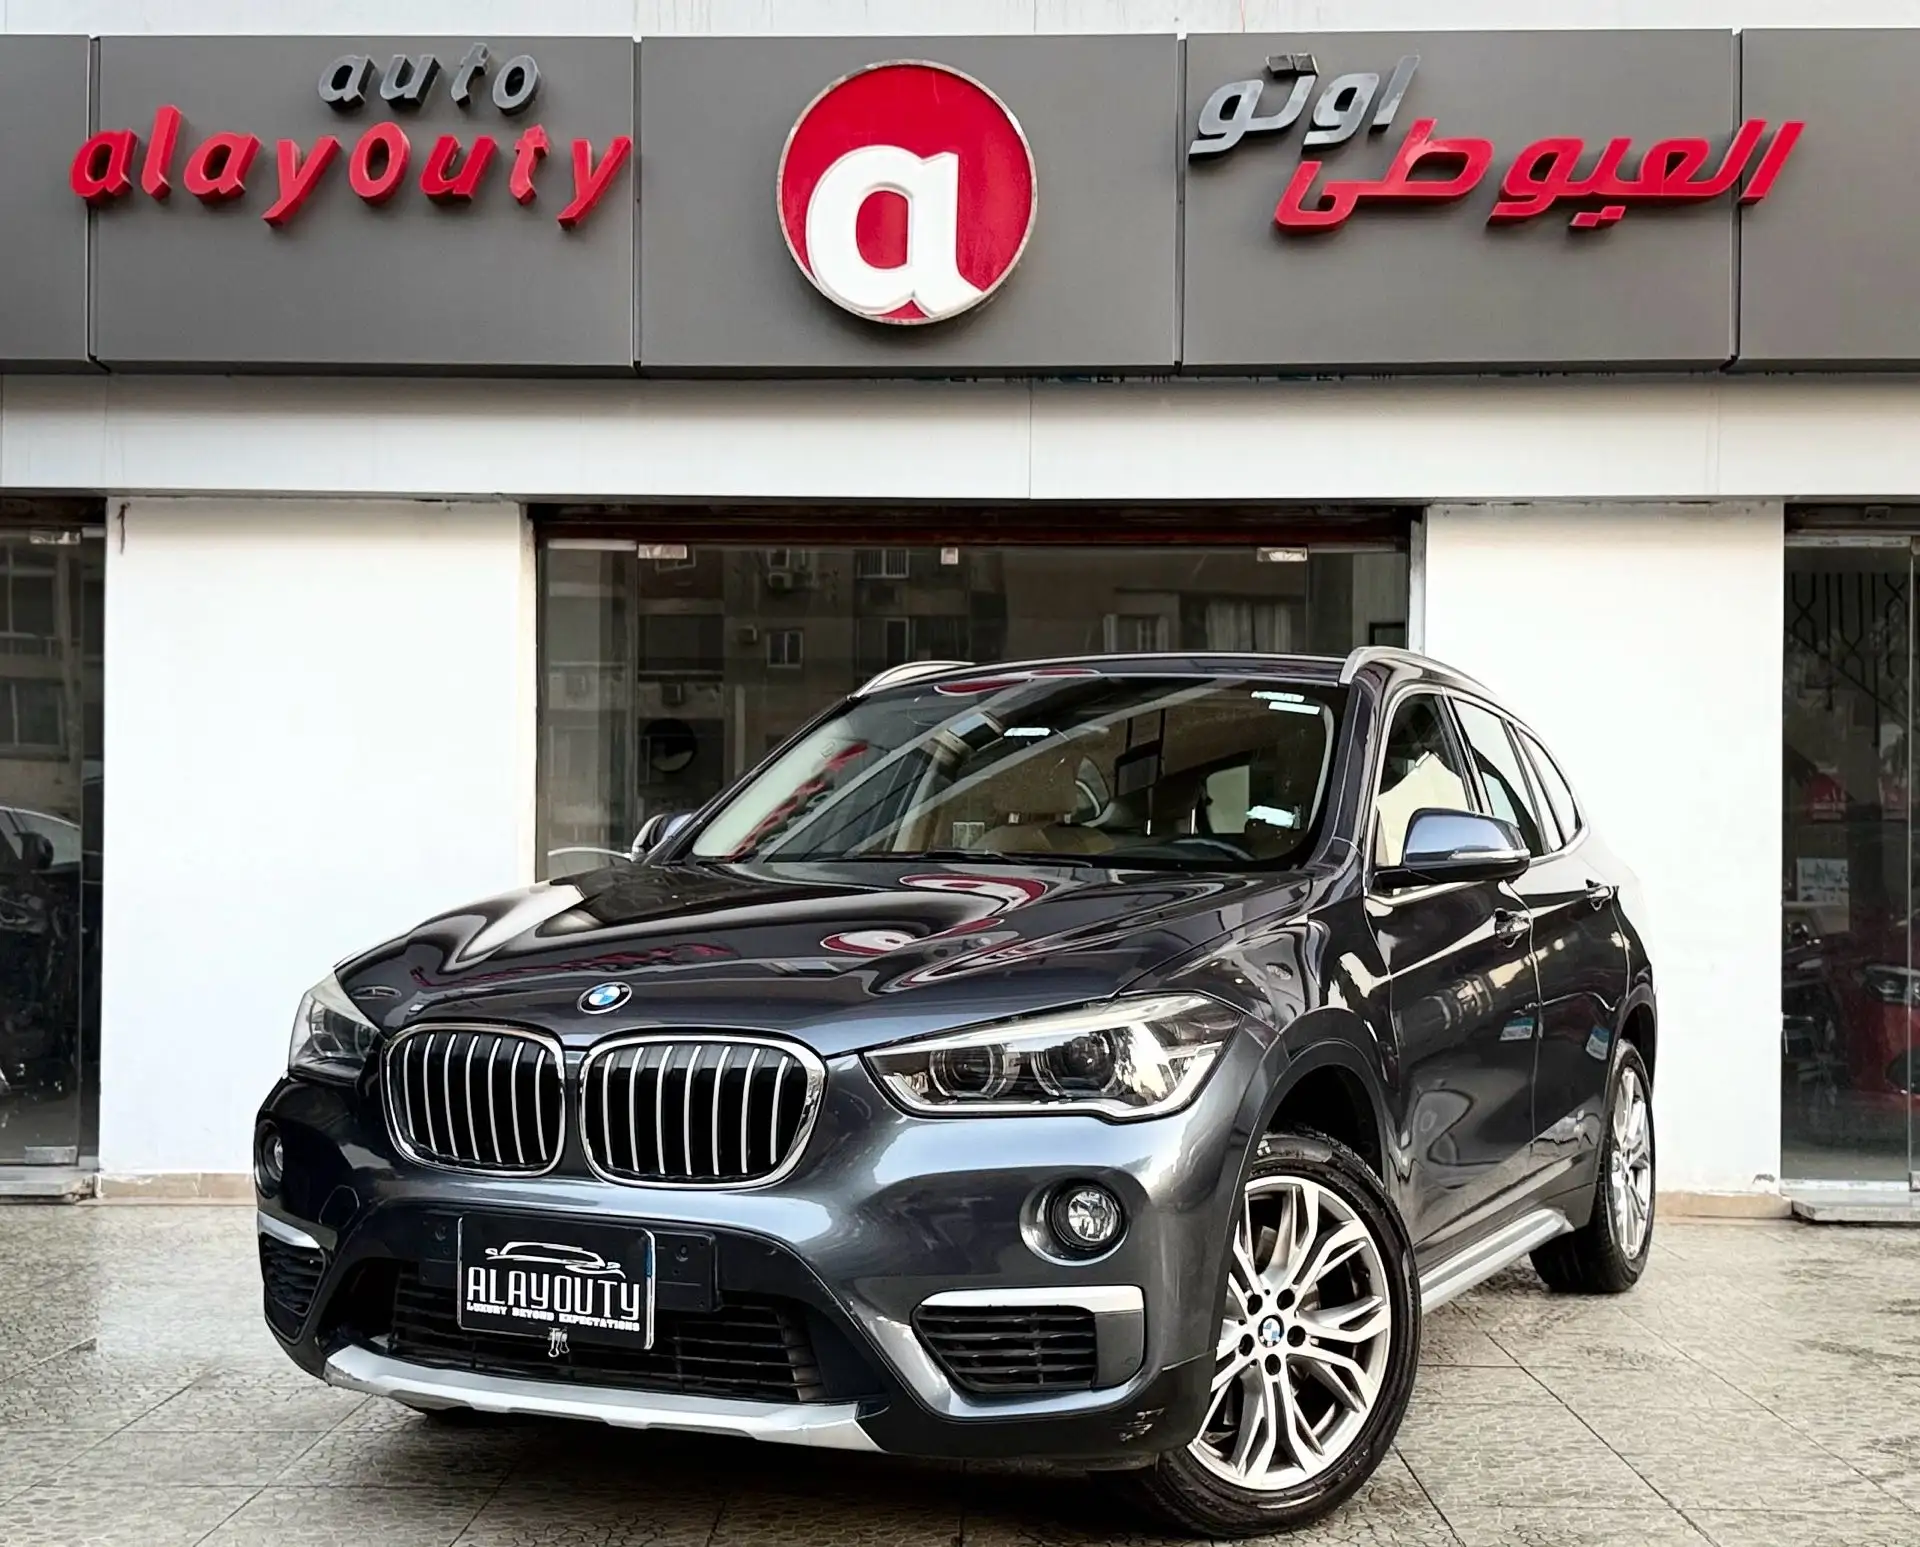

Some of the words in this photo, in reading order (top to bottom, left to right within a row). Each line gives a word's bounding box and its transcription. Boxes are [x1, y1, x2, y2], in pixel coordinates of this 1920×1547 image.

[318, 43, 541, 115] auto
[70, 105, 632, 229] alayouty
[806, 144, 986, 318] a
[467, 1267, 640, 1320] ALAYOUTY
[558, 1313, 641, 1332] EXPECTATIONS
